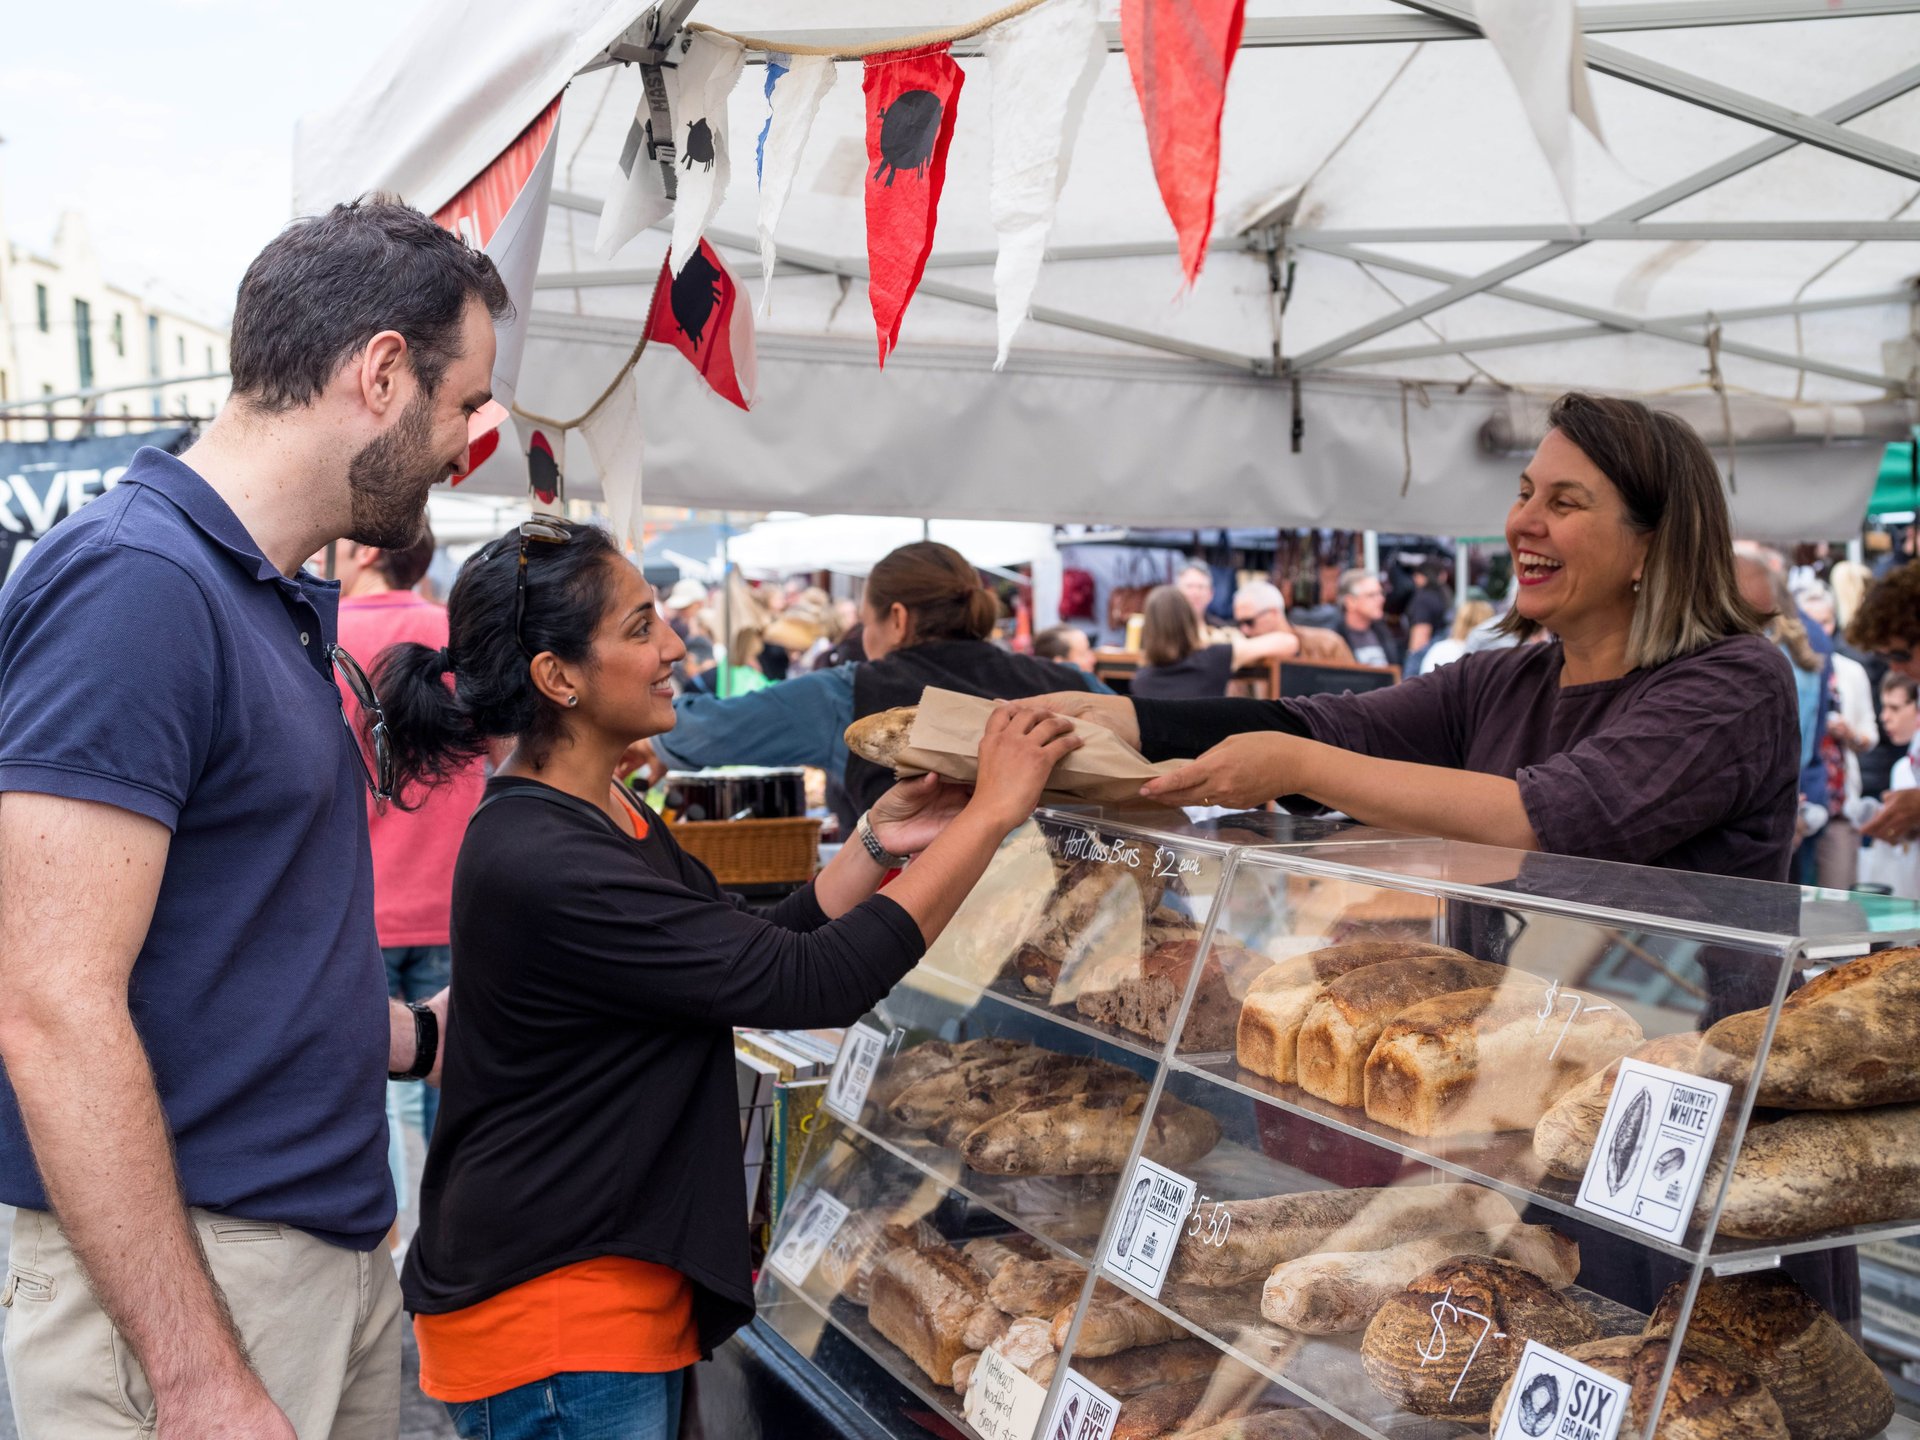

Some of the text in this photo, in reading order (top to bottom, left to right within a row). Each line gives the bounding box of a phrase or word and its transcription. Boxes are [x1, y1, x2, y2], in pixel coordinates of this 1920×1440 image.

[1107, 838, 1141, 868] Buns
[1152, 845, 1179, 878] $2
[1178, 853, 1201, 876] each
[1673, 1088, 1713, 1112] COUNTRY
[1668, 1102, 1708, 1131] WHITE
[1153, 1178, 1185, 1206] ITALIAN
[1149, 1195, 1179, 1221] CIABATTA
[1086, 1398, 1110, 1427] LIGHT
[1568, 1379, 1612, 1430] SIX
